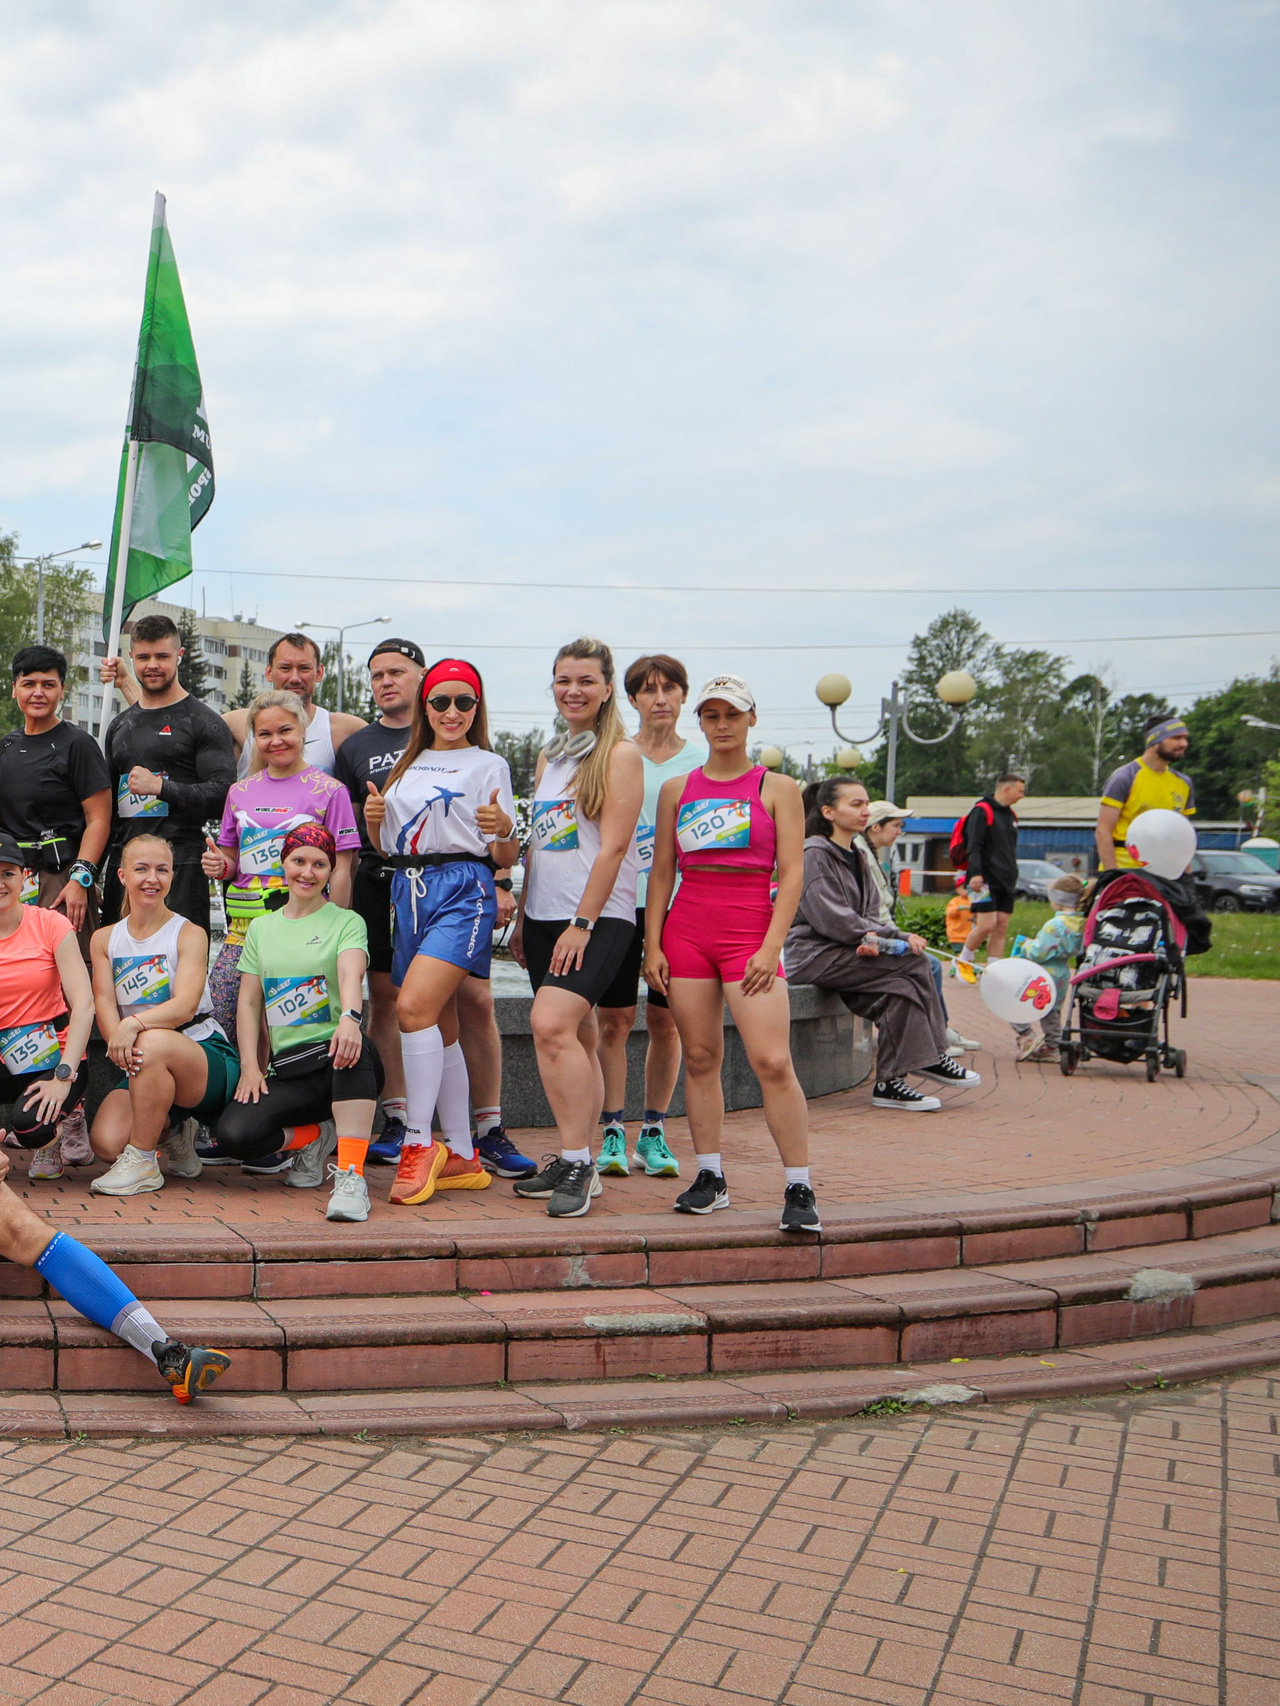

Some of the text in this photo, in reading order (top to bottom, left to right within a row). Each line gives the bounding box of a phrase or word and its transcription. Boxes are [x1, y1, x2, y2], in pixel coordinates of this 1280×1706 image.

[407, 765, 447, 773] РОФЛОТ
[535, 816, 557, 841] 134
[691, 815, 725, 840] 120
[251, 844, 280, 865] 136
[122, 971, 148, 996] 145
[277, 992, 308, 1017] 102
[10, 1039, 39, 1065] 135
